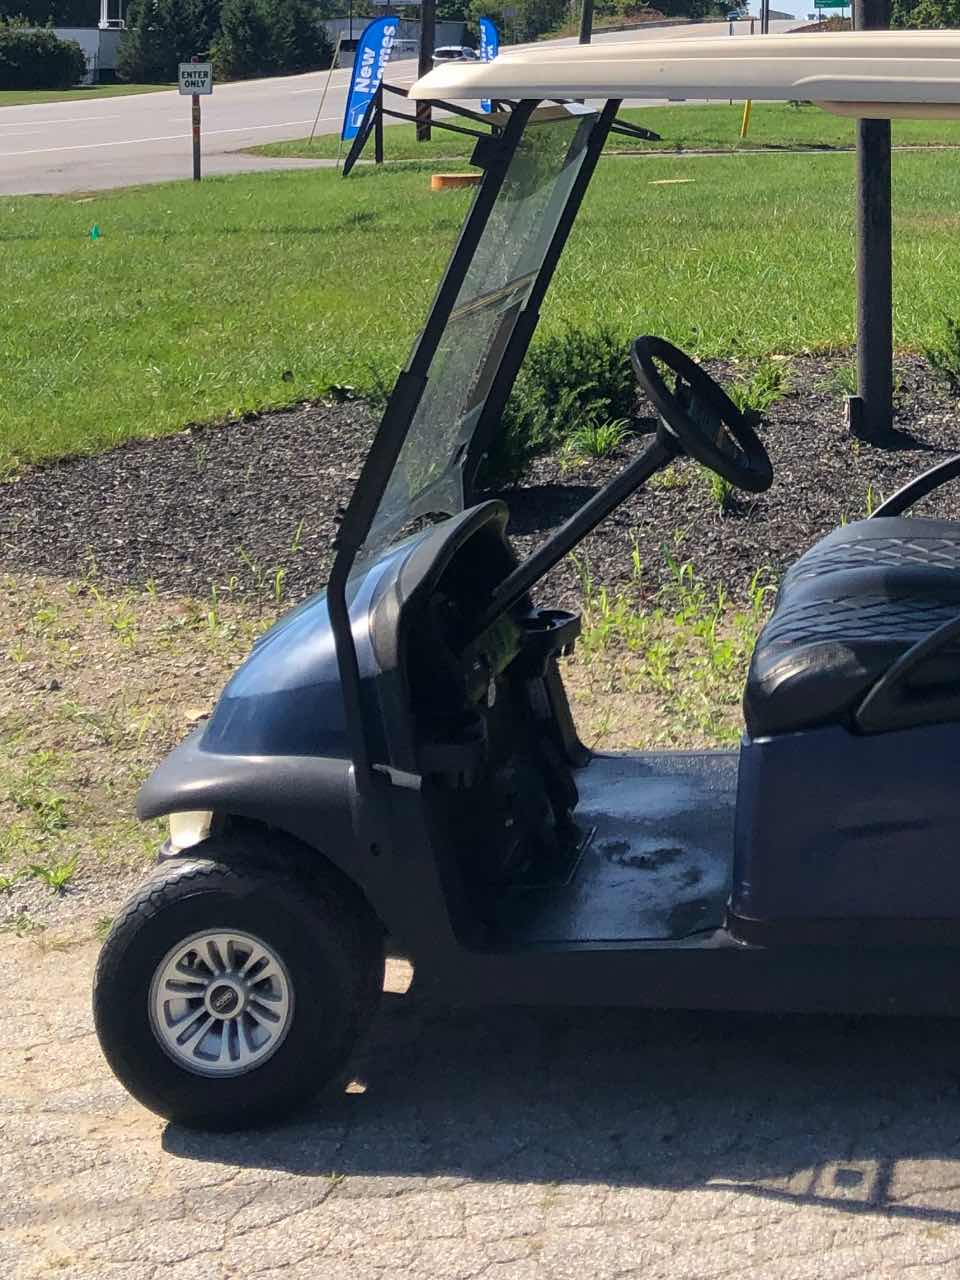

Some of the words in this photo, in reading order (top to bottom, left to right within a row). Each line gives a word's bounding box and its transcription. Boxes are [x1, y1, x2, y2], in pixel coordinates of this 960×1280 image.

[181, 70, 208, 79] ENTER
[353, 47, 376, 93] New
[184, 79, 206, 88] ONLY
